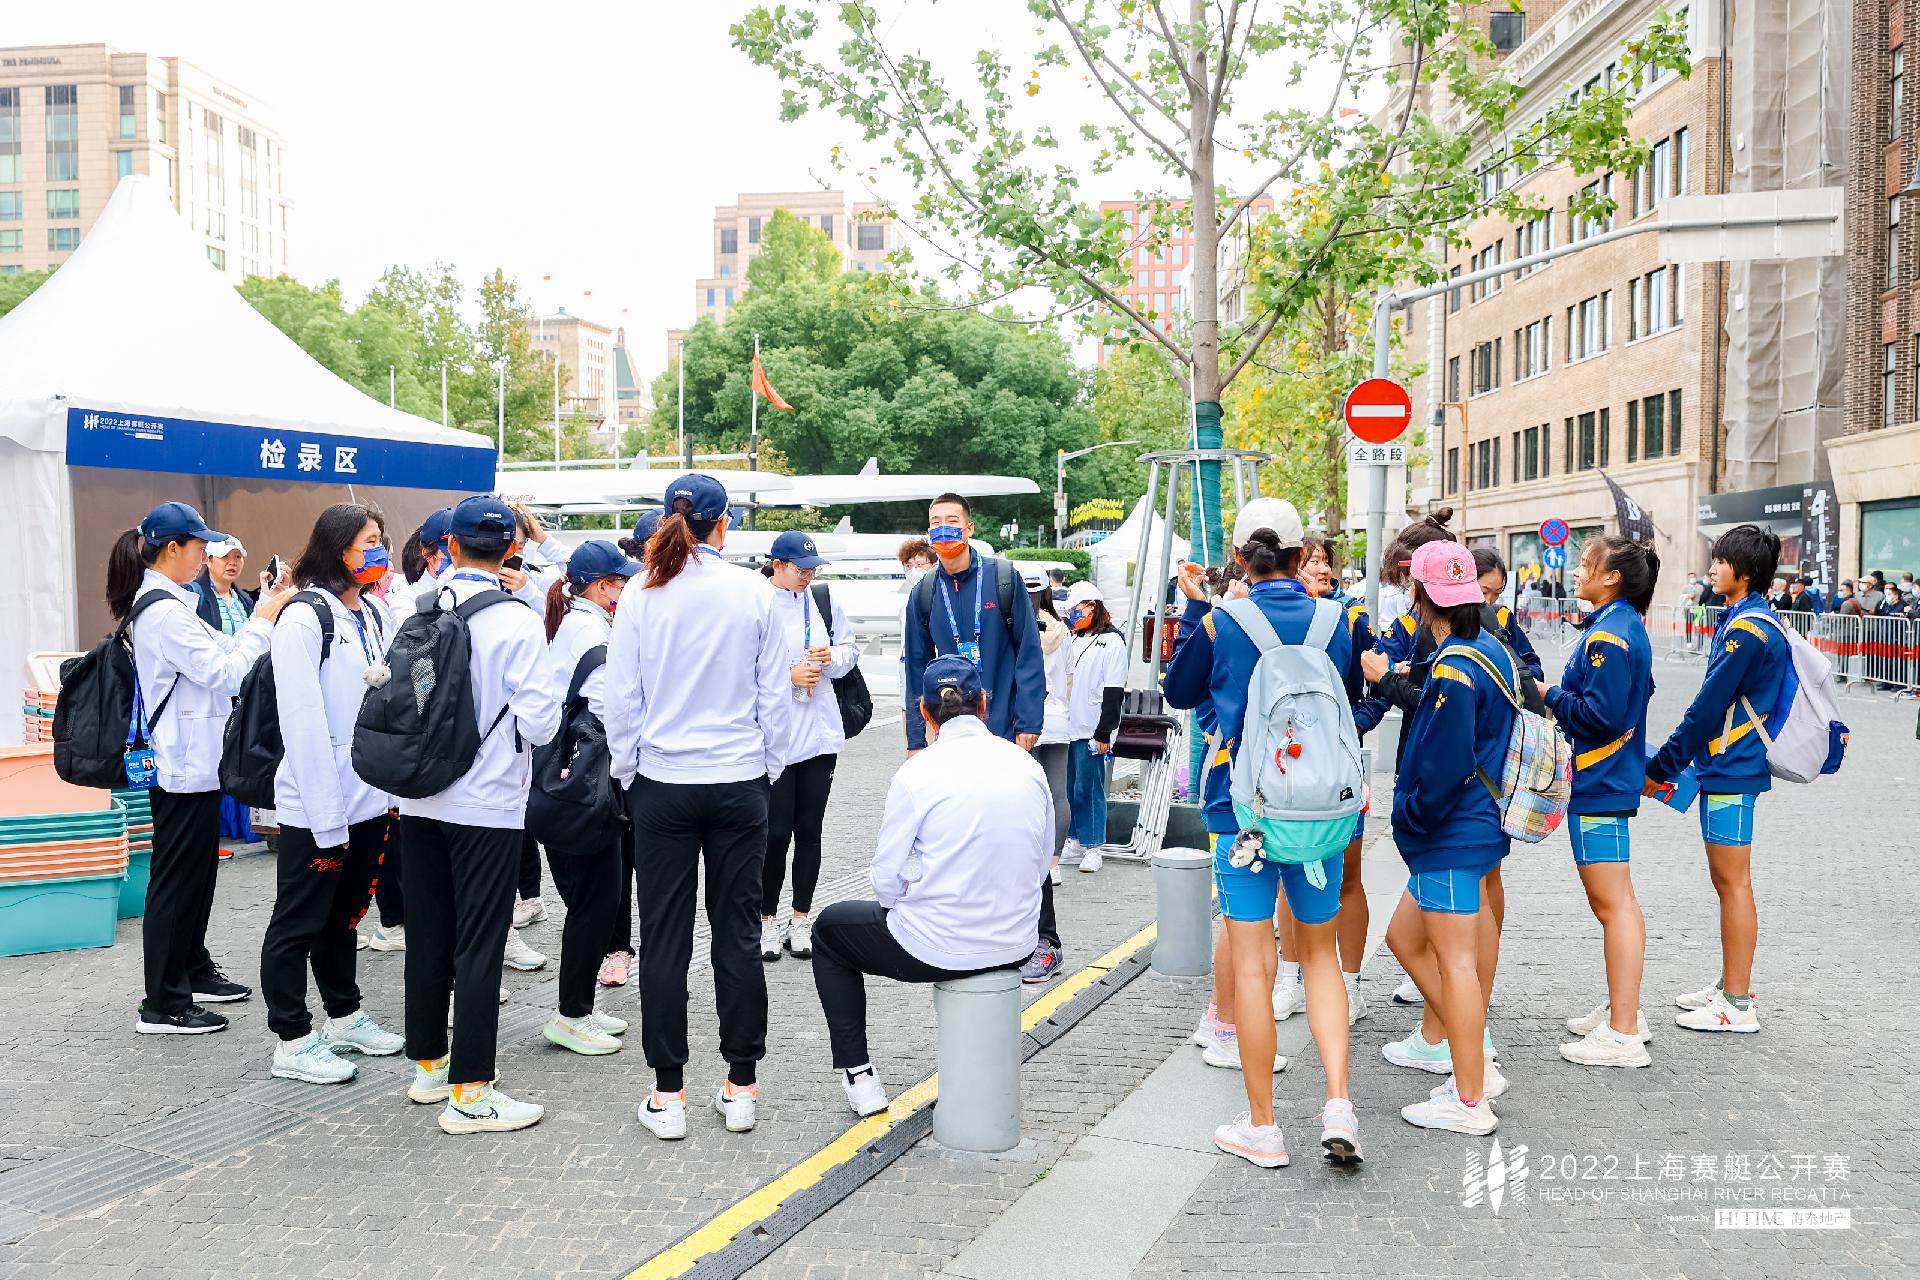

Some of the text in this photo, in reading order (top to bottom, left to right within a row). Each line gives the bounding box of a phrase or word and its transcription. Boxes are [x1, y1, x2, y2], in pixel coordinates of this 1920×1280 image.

[260, 438, 358, 474] 检录区
[1354, 447, 1403, 461] 全路段
